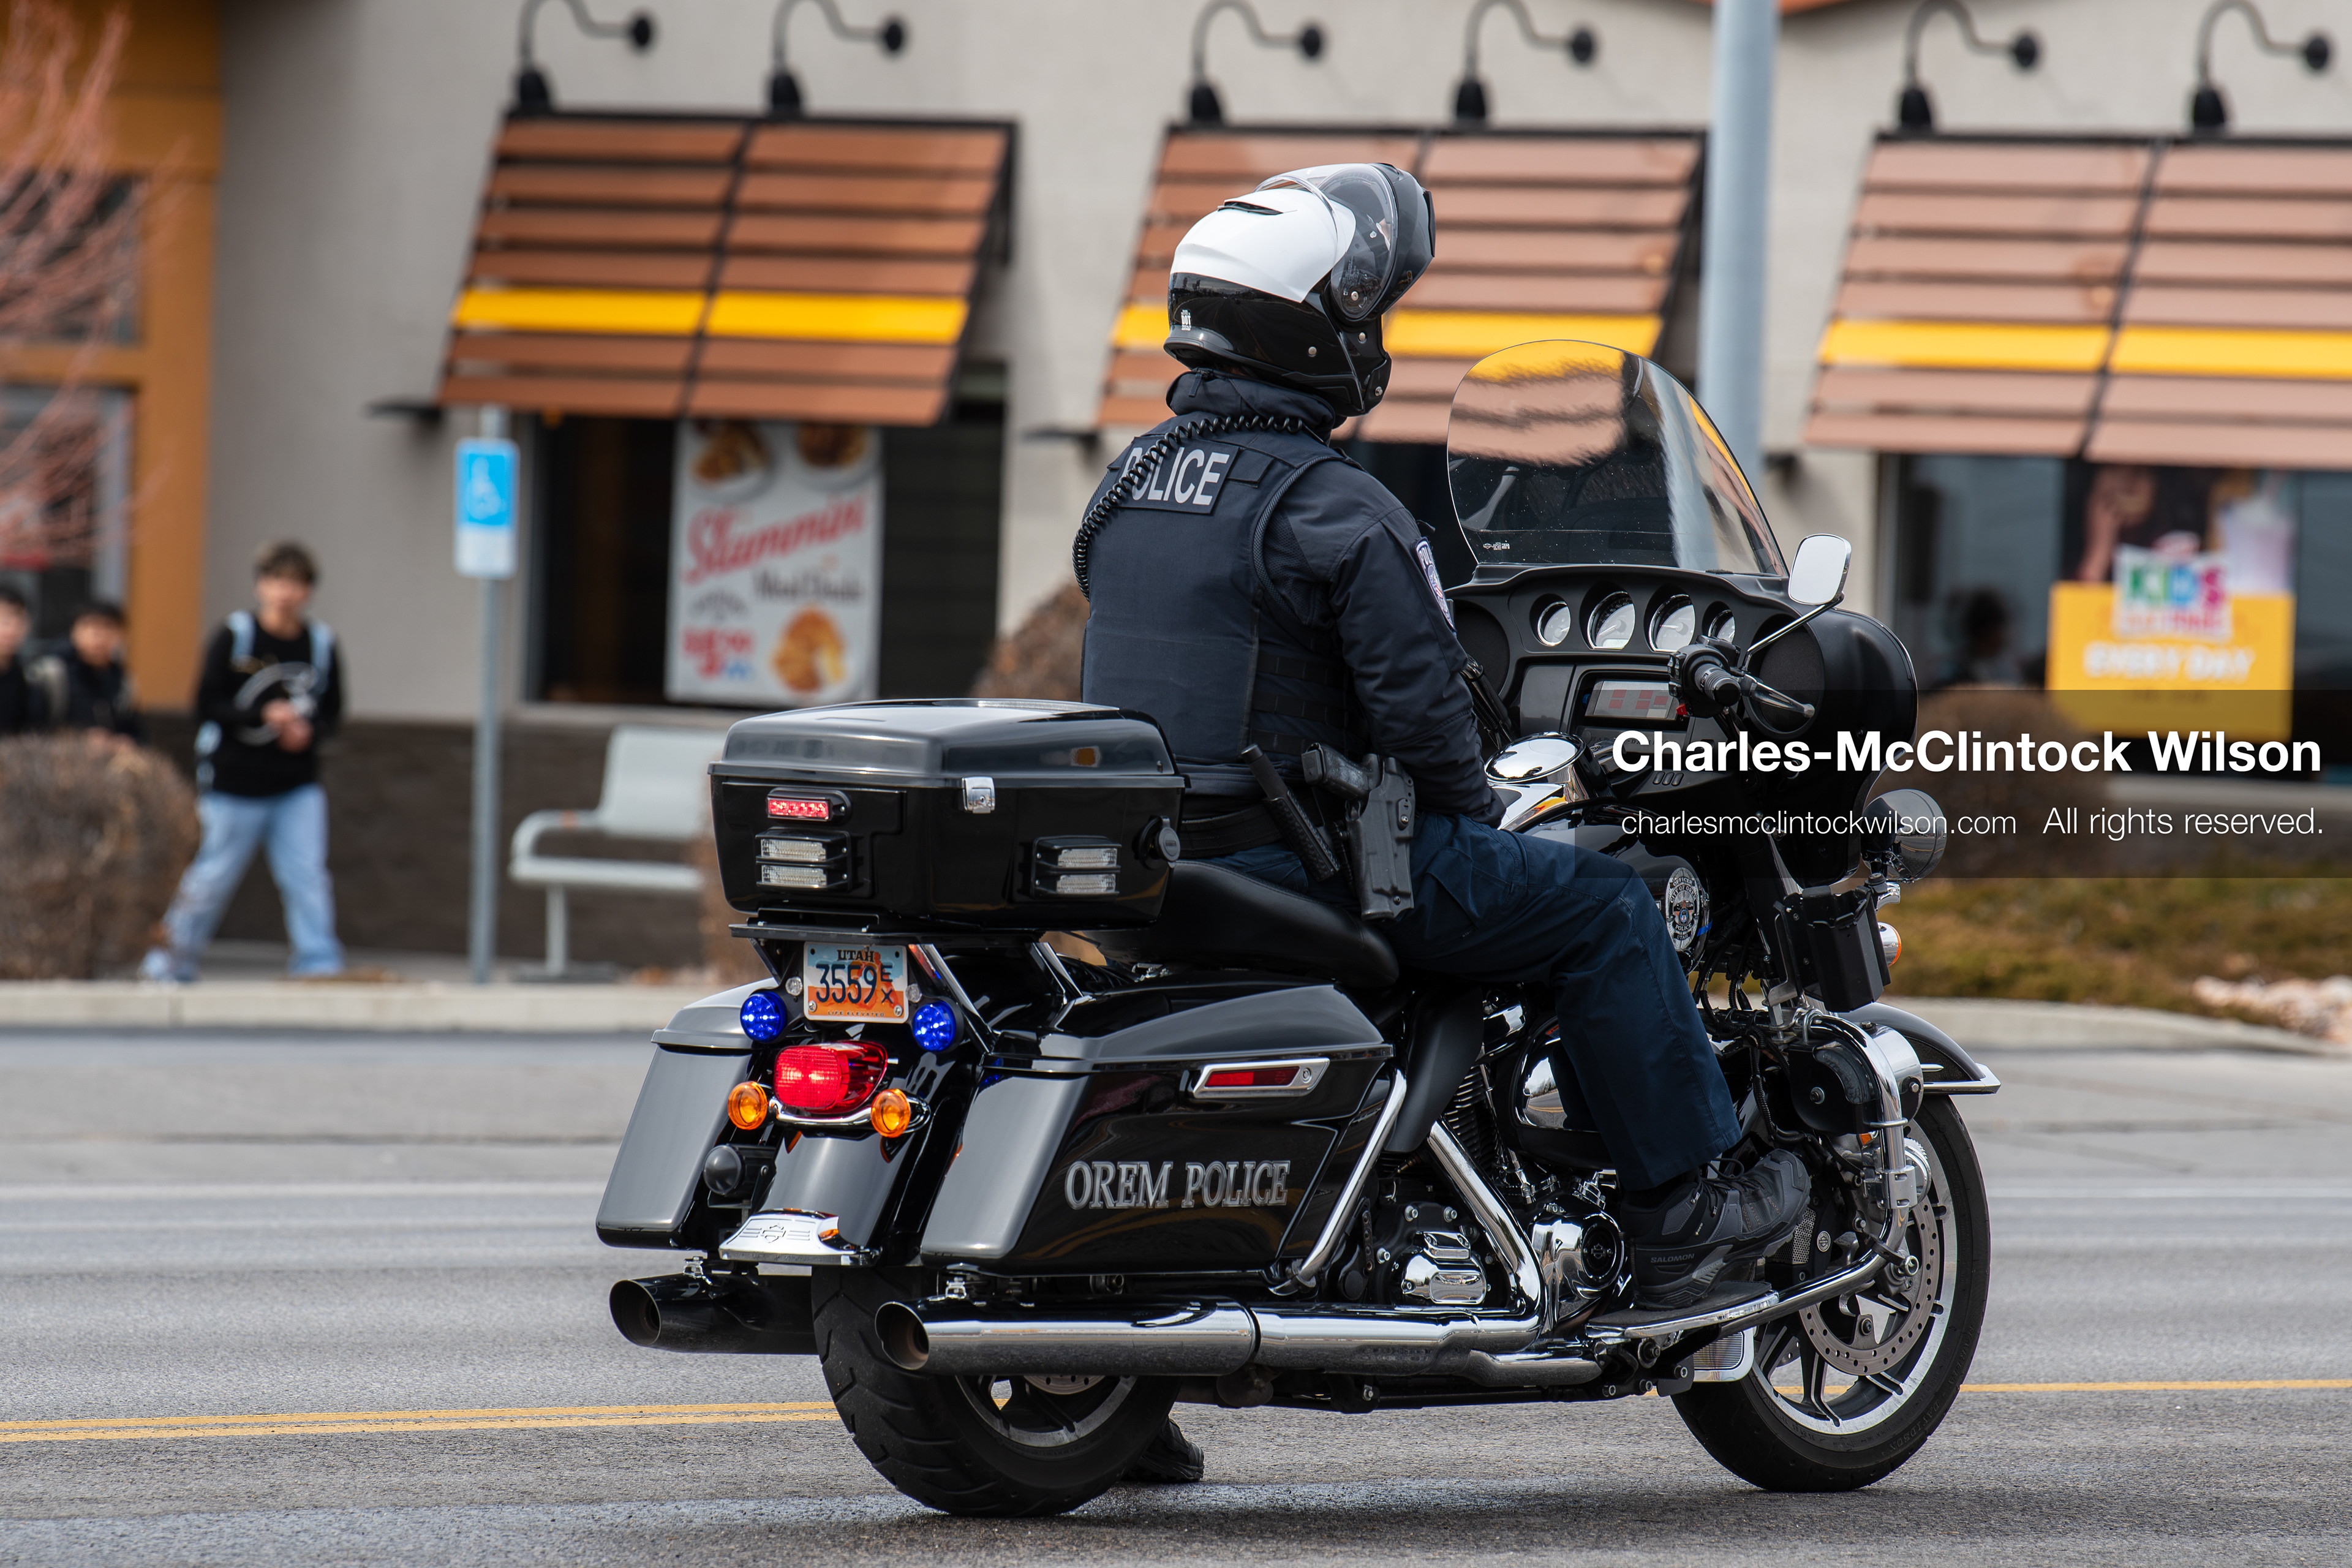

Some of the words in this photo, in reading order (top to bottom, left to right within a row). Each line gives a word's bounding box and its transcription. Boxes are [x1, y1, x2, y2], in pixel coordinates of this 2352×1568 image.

[1182, 315, 1191, 325] DOT
[2187, 646, 2253, 681] DAY
[1673, 877, 1693, 886] OFFICER
[1675, 922, 1692, 931] POLICE
[837, 949, 875, 962] UTAH
[816, 963, 877, 1005] 3559
[1065, 1160, 1174, 1210] OREM
[1181, 1159, 1291, 1209] POLICE
[1650, 1253, 1695, 1264] SALOMON
